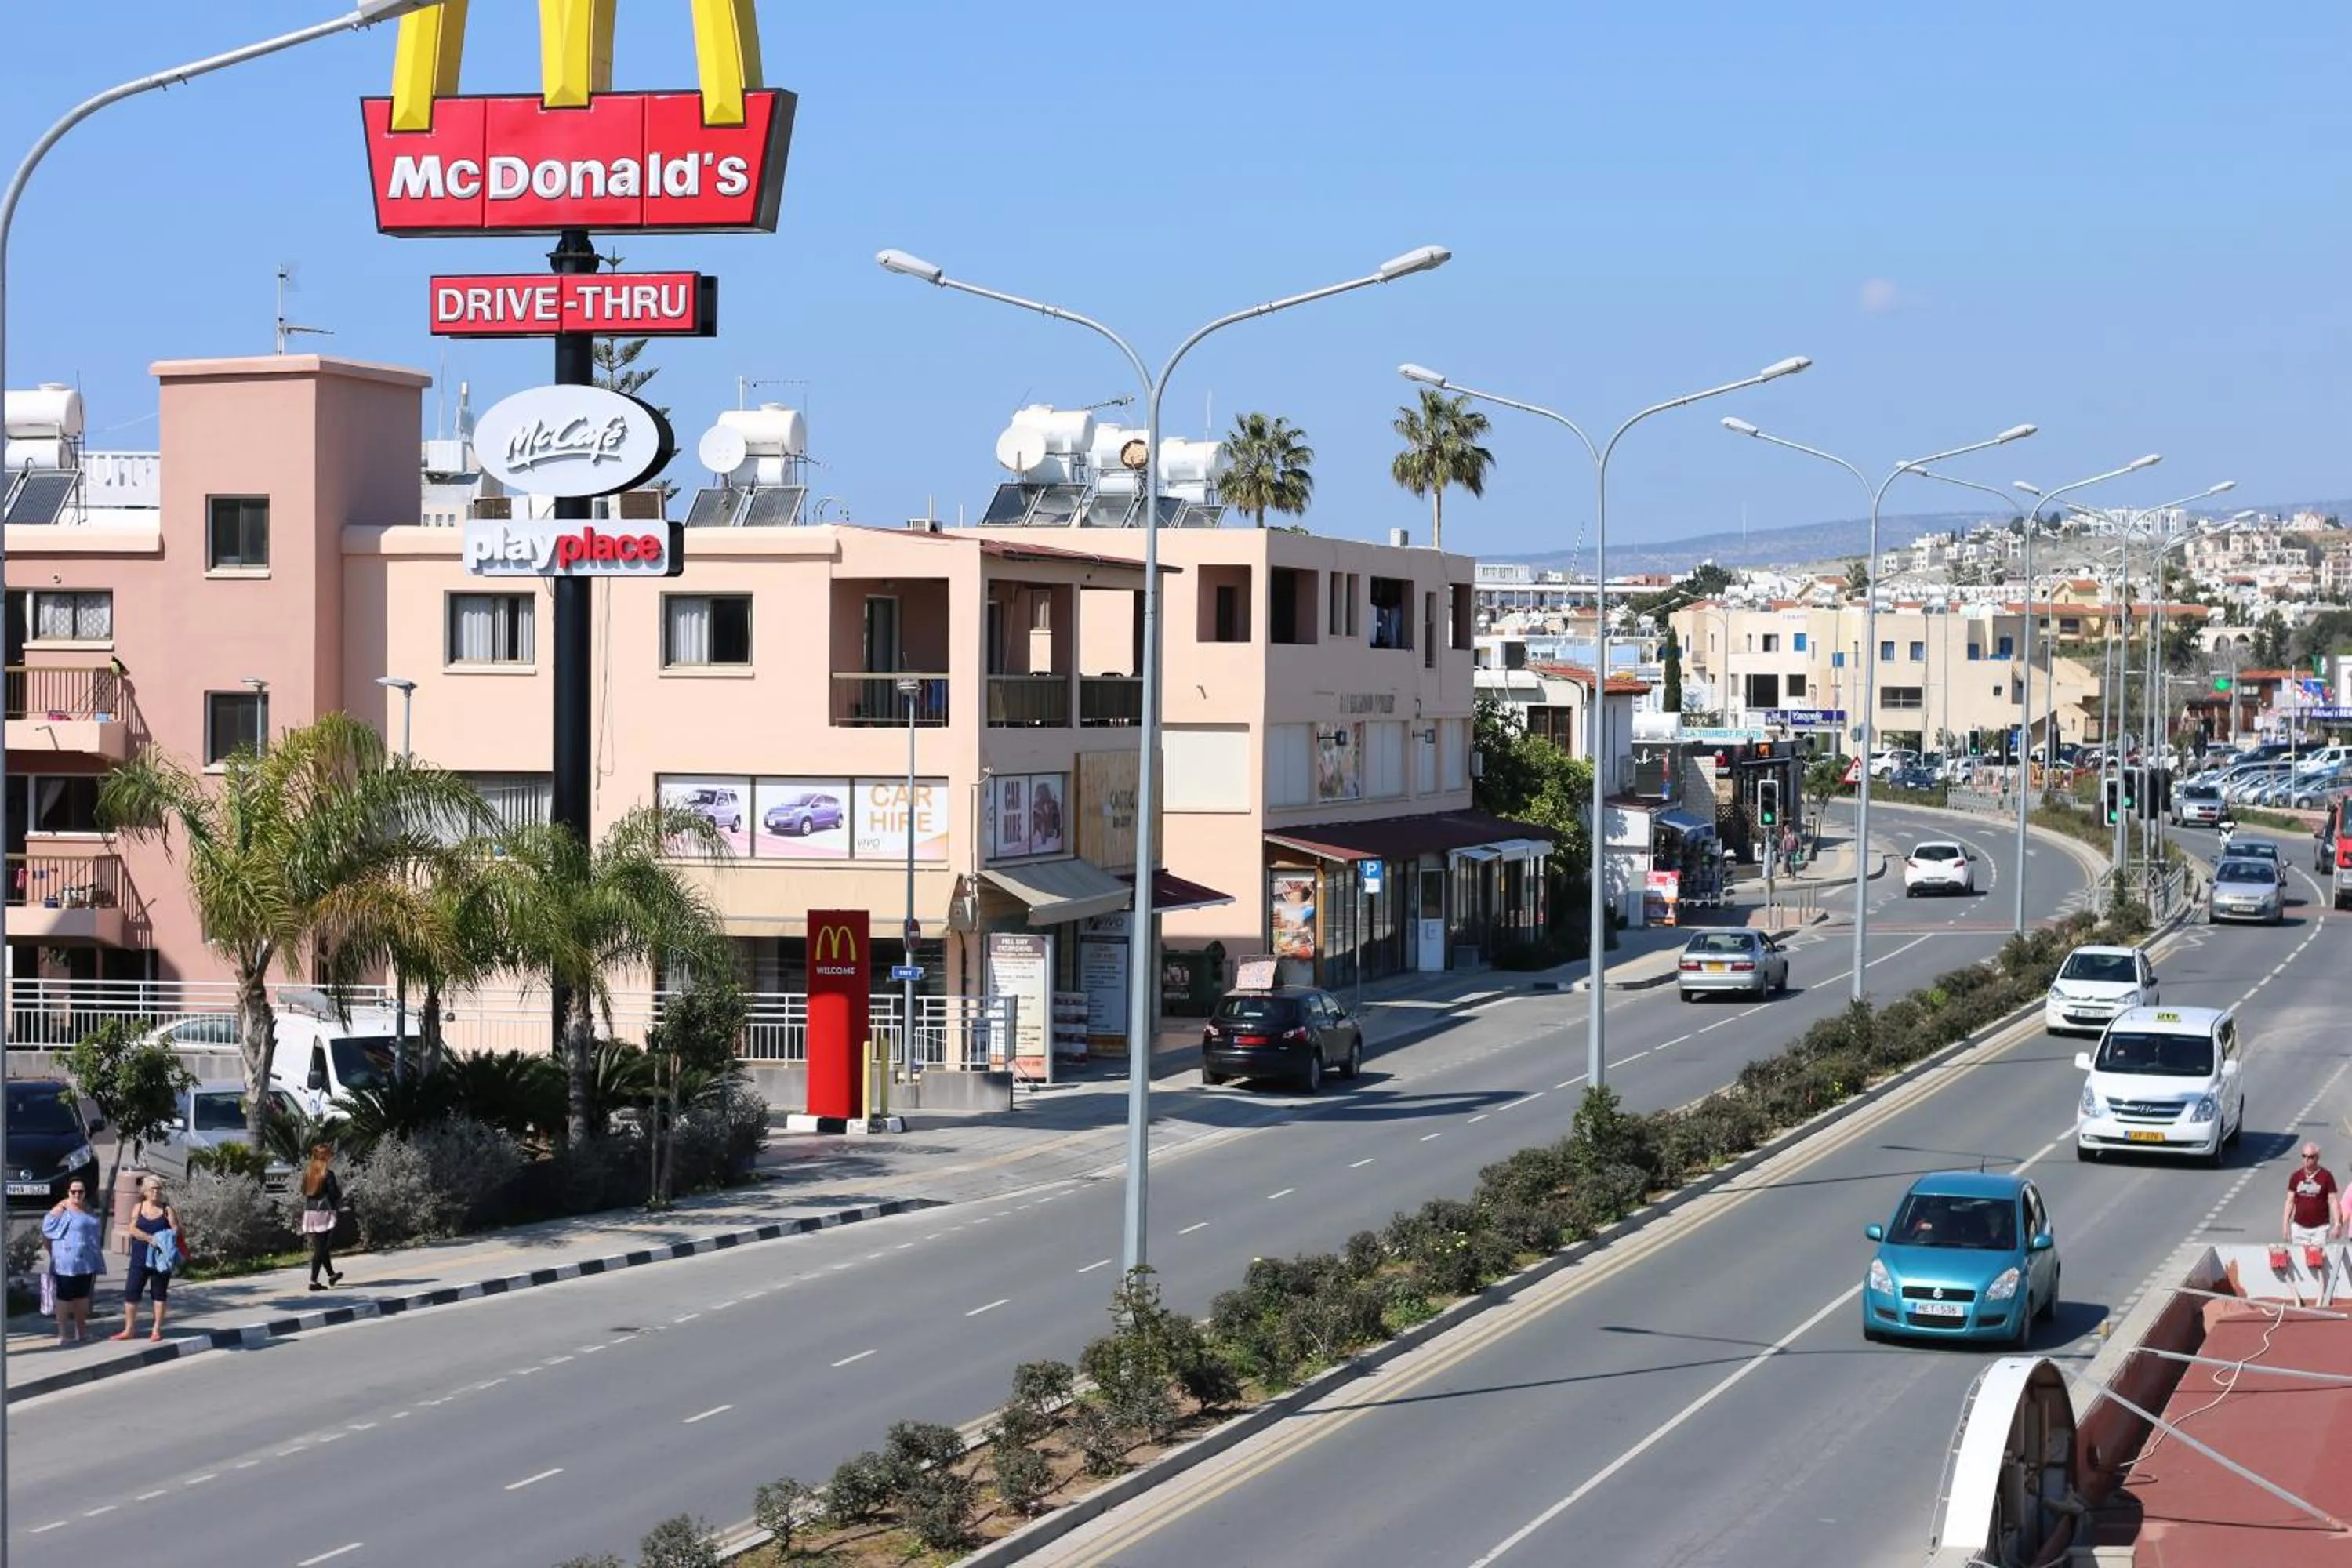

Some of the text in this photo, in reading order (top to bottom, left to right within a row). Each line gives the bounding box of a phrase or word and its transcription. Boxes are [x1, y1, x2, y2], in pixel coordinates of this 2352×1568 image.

[387, 151, 750, 200] McDonald's
[437, 284, 688, 321] DRIVE-THRU
[869, 783, 932, 808] CAR
[1004, 781, 1021, 811] CAR
[816, 966, 856, 975] WELCOME
